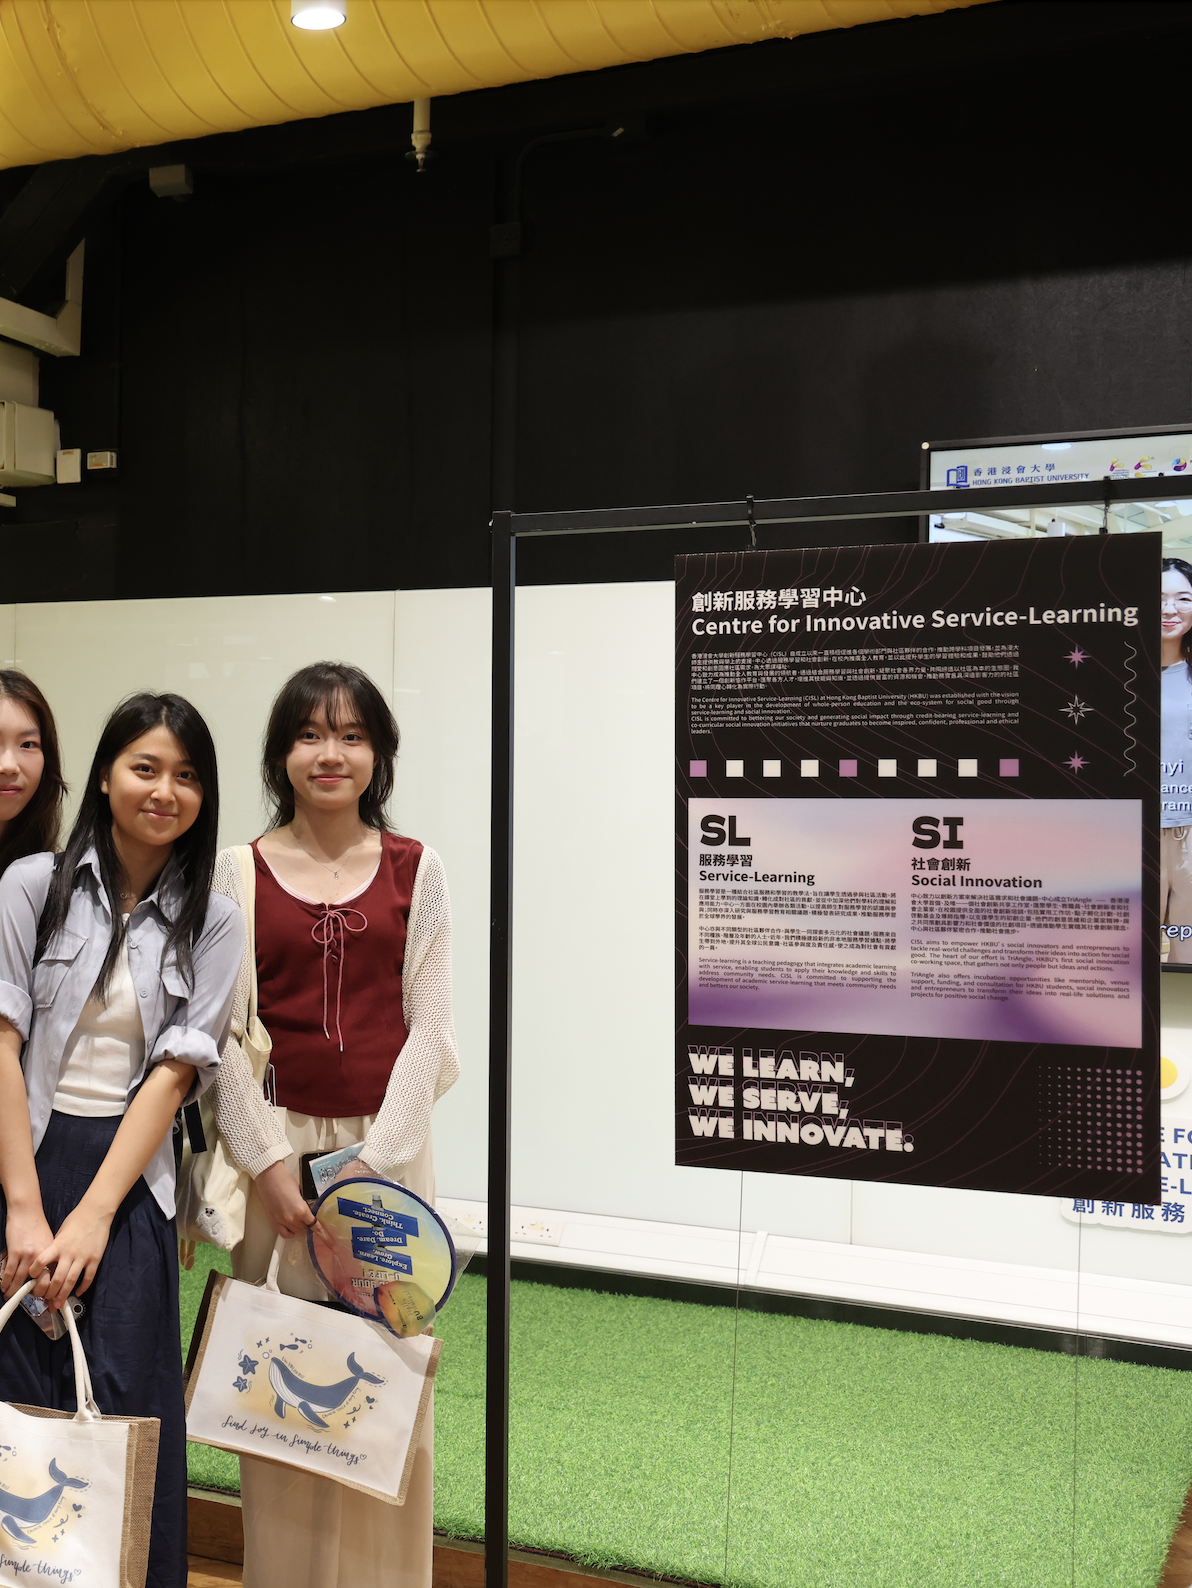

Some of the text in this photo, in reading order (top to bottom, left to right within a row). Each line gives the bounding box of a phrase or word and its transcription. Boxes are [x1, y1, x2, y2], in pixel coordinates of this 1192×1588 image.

[973, 462, 1056, 477] 香港浸會大學
[972, 472, 1090, 487] HONG KONG BAPTIST UNIVERSITY
[691, 586, 867, 613] 創新服務學習中心
[691, 603, 1139, 636] Centre for Innovative Service-Learning
[700, 814, 752, 847] SL
[911, 815, 964, 850] SI
[699, 853, 753, 868] 服務學習
[911, 857, 971, 872] 社會創新
[699, 869, 816, 887] Service-Learning
[911, 874, 1043, 889] Social Innovation
[688, 1051, 855, 1087] WE LEARN,
[688, 1083, 849, 1119] WE SERVE,
[688, 1113, 915, 1153] WE INNOVATE.
[352, 1210, 404, 1229] Think. Create.
[362, 1207, 395, 1220] Connect.
[376, 1236, 403, 1244] Dream.
[357, 1250, 408, 1270] Explore. Learn.
[372, 1249, 393, 1259] Grow.
[250, 1422, 269, 1439] joy
[271, 1432, 288, 1443] in
